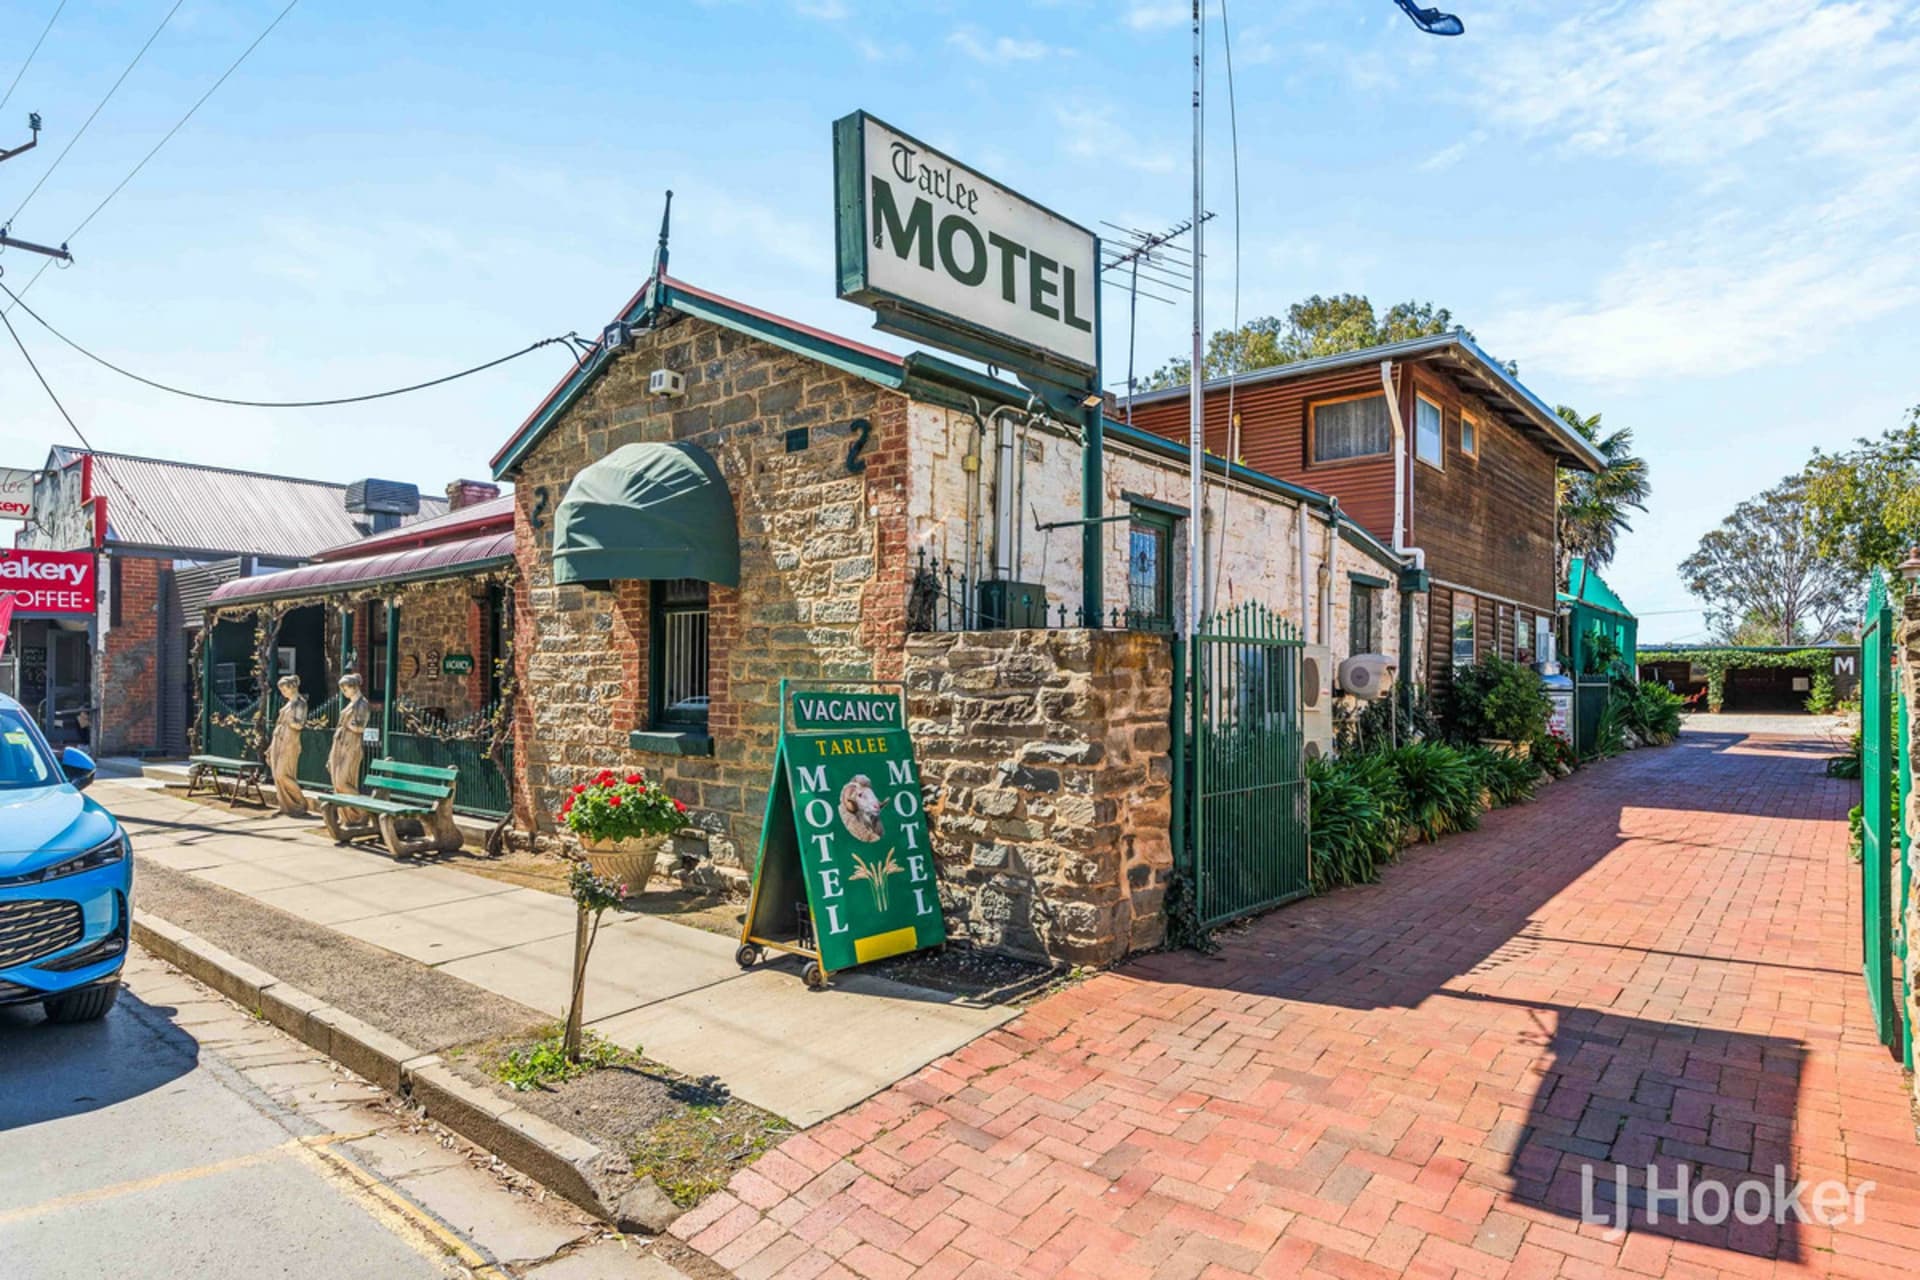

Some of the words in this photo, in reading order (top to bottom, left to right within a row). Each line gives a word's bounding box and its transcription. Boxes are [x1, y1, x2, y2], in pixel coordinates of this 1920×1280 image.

[891, 141, 979, 216] Tarlee
[871, 175, 1092, 334] MOTEL
[0, 468, 29, 494] lee
[0, 556, 88, 586] akery
[1834, 656, 1855, 676] M
[799, 698, 898, 722] VACANCY
[815, 736, 889, 757] TARLEE
[796, 764, 850, 936] MOTEL
[886, 758, 934, 917] MOTEL
